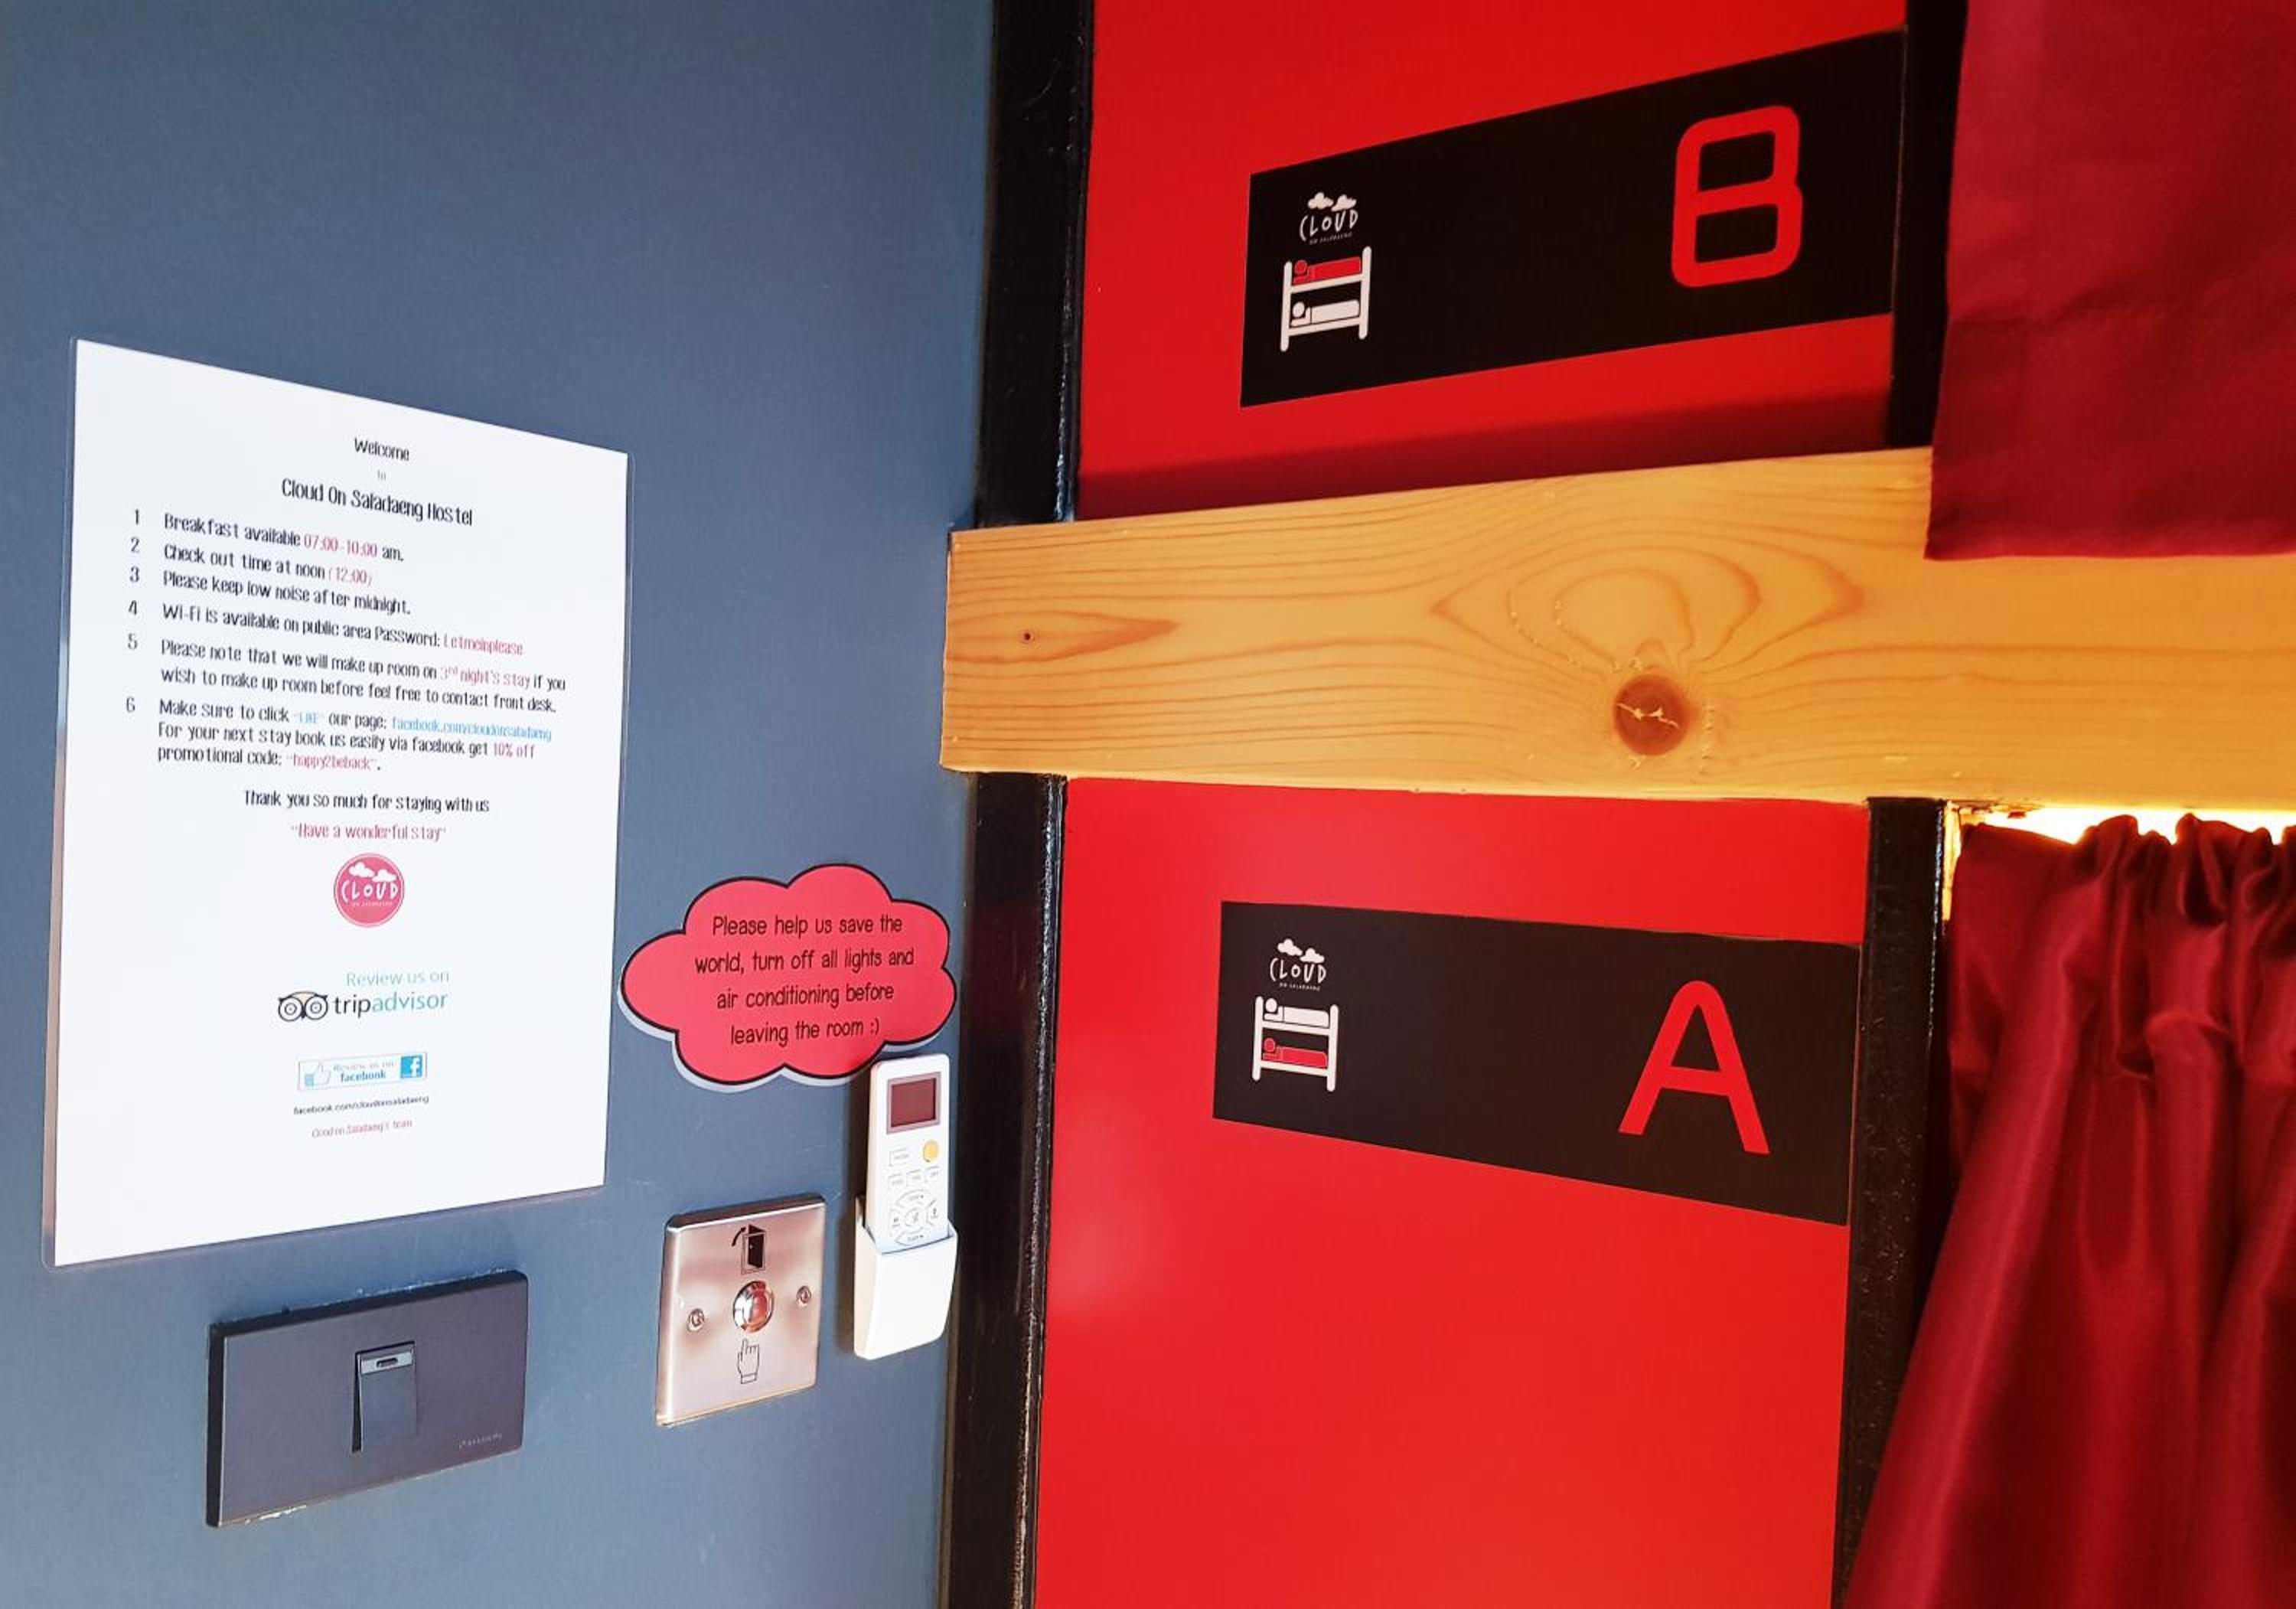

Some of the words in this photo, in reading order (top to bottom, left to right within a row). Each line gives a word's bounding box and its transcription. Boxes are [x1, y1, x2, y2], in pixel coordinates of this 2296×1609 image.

[1671, 105, 1803, 287] B
[1300, 209, 1358, 242] CLOUD
[354, 438, 409, 462] Welcome
[282, 478, 323, 502] Cloud
[328, 486, 346, 506] On
[351, 489, 423, 522] Saladaeng
[427, 502, 473, 526] Hostel
[134, 509, 139, 525] 1
[163, 513, 238, 539] Breakfast
[244, 528, 300, 547] available
[382, 544, 404, 562] am.
[130, 537, 139, 553] 2
[164, 544, 205, 564] Check
[210, 551, 234, 567] out
[242, 554, 271, 572] time
[276, 560, 290, 576] at
[295, 563, 325, 579] noon
[129, 566, 139, 582] 3
[163, 570, 207, 590] Please
[212, 575, 243, 596] keep
[247, 581, 271, 598] low
[276, 583, 310, 602] noise
[313, 589, 350, 606] after
[354, 595, 411, 616] midnight.
[128, 600, 138, 615] 4
[162, 602, 201, 622] Wi-Fi
[206, 608, 217, 623] is
[223, 610, 279, 631] available
[284, 616, 298, 631] on
[303, 618, 339, 636] public
[343, 624, 371, 640] area
[375, 625, 440, 647] Password:
[128, 634, 137, 650] 5
[161, 639, 206, 659] Please
[210, 646, 241, 661] note
[248, 648, 276, 664] that
[282, 652, 302, 667] we
[306, 653, 328, 669] will
[332, 656, 365, 673] make
[368, 661, 383, 675] up
[387, 662, 419, 678] room
[423, 666, 437, 679] on
[460, 668, 500, 686] night's
[504, 672, 530, 689] stay
[533, 674, 543, 690] if
[546, 677, 566, 692] you
[161, 667, 195, 684] wish
[202, 670, 217, 685] to
[221, 671, 257, 689] make
[263, 677, 277, 692] up
[282, 677, 317, 694] room
[321, 679, 363, 697] before
[368, 683, 390, 699] feel
[395, 684, 420, 701] free
[426, 688, 438, 703] to
[442, 690, 488, 707] contact
[494, 694, 523, 710] front
[528, 697, 556, 713] desk.
[126, 697, 135, 713] 6
[160, 699, 197, 716] Make
[202, 703, 233, 719] sure
[240, 704, 255, 720] to
[258, 706, 289, 723] click
[328, 712, 351, 726] our
[354, 713, 386, 732] page:
[158, 722, 182, 738] For
[188, 726, 219, 742] your
[223, 727, 254, 743] next
[259, 728, 292, 747] stay
[295, 729, 325, 746] book
[330, 734, 345, 747] us
[350, 734, 385, 752] easily
[390, 736, 407, 751] via
[413, 737, 465, 755] facebook
[469, 742, 488, 759] get
[494, 742, 513, 757] 10%
[517, 743, 535, 759] off
[158, 746, 243, 764] promotional
[247, 749, 281, 766] code:
[245, 790, 281, 806] Thank
[286, 793, 309, 808] you
[313, 794, 329, 808] so
[333, 792, 367, 808] much
[372, 795, 393, 808] for
[396, 796, 441, 813] staying
[445, 797, 473, 812] with
[475, 799, 490, 812] us
[333, 825, 341, 837] a
[345, 823, 408, 840] wonderful
[341, 880, 399, 903] CLOUD
[713, 916, 766, 936] Please
[775, 916, 808, 938] help
[815, 918, 832, 935] us
[839, 918, 873, 933] save
[880, 915, 902, 932] the
[695, 952, 745, 974] world,
[752, 951, 784, 971] turn
[791, 950, 815, 970] off
[821, 949, 838, 968] all
[844, 948, 882, 973] lights
[889, 948, 914, 966] and
[1270, 958, 1326, 984] CLOUD
[347, 971, 403, 987] Review
[407, 971, 425, 984] us
[429, 970, 449, 983] on
[334, 991, 448, 1019] tripadvisor
[717, 988, 739, 1009] air
[745, 984, 840, 1009] conditioning
[846, 983, 894, 1002] before
[731, 1025, 788, 1046] leaving
[796, 1021, 820, 1039] the
[826, 1020, 863, 1037] room
[341, 1069, 386, 1082] facebook
[1619, 980, 1770, 1155] A
